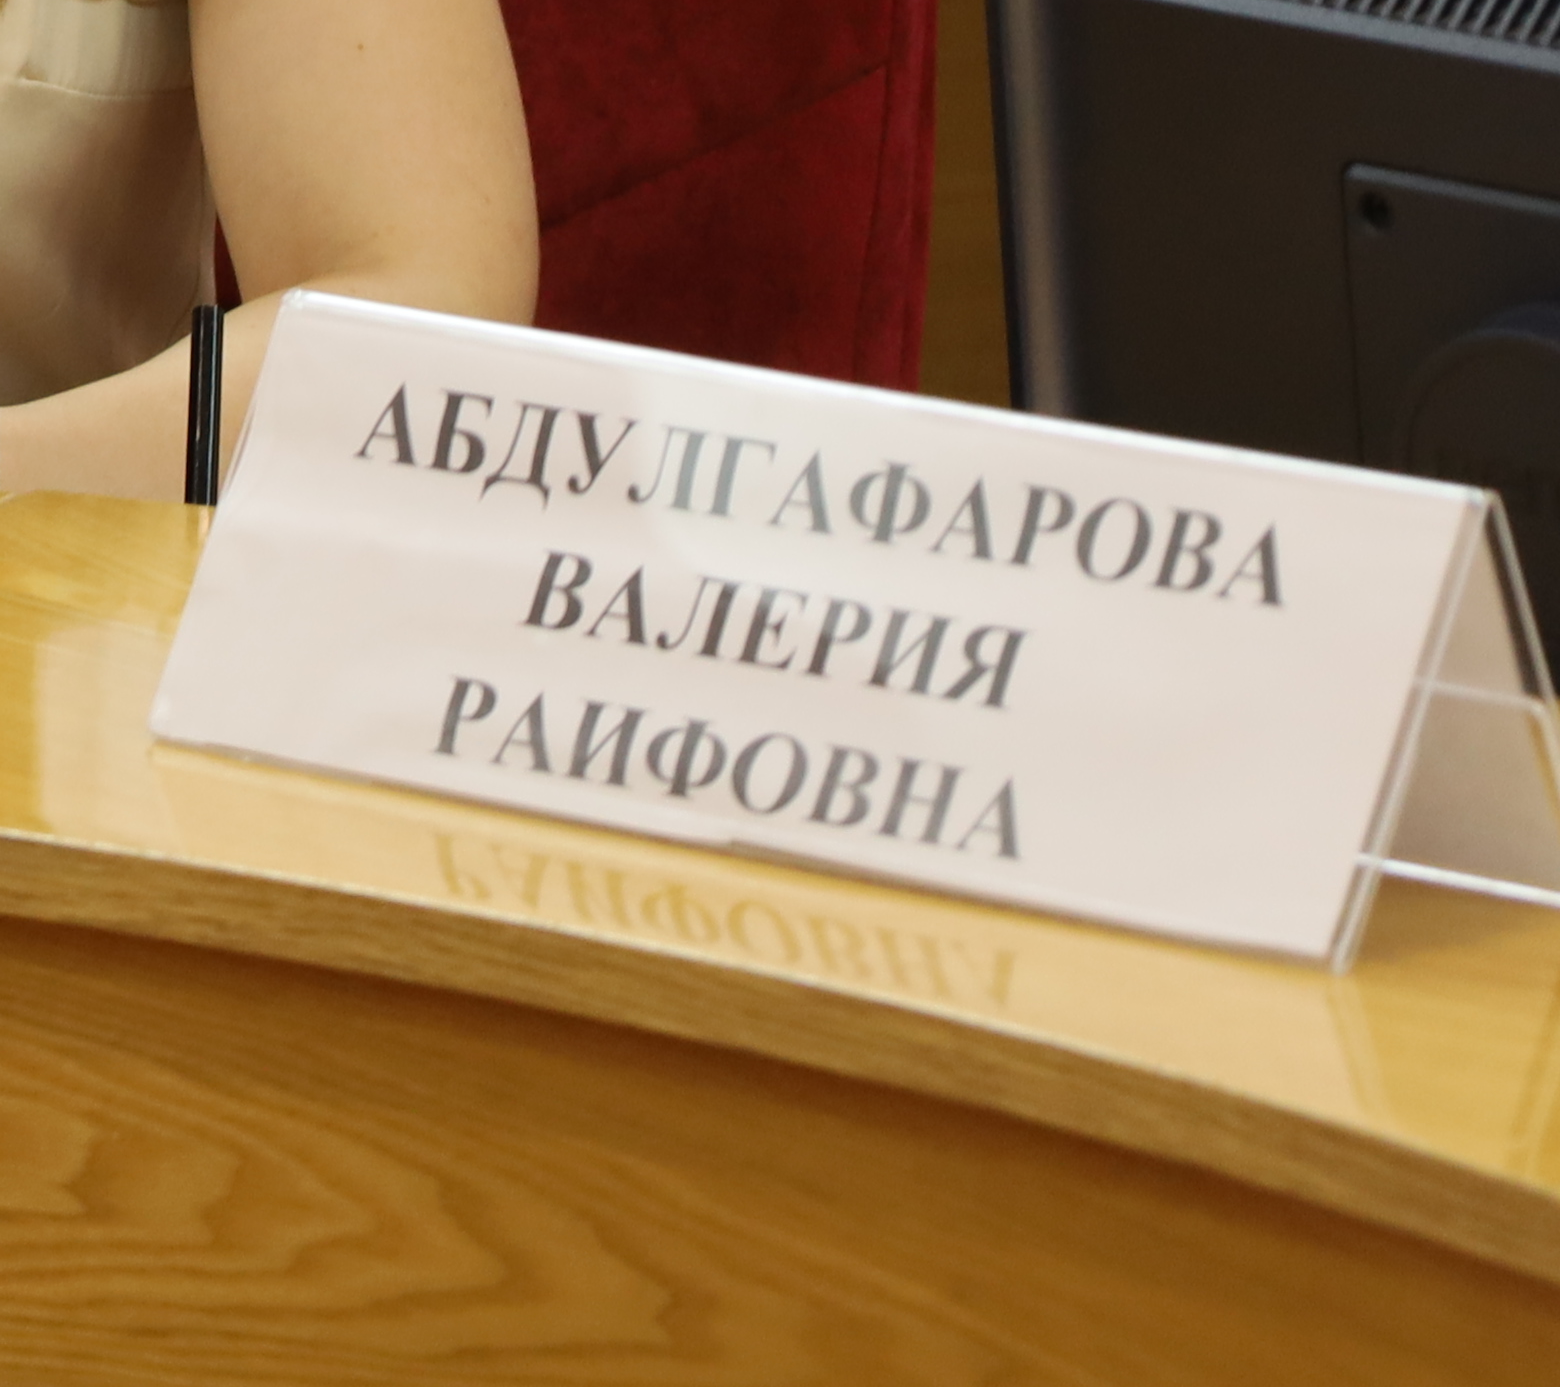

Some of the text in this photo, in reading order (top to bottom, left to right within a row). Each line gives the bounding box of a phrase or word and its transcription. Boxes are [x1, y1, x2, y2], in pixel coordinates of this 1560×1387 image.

[352, 381, 1286, 609] АБДУЛГАФАРОВА
[519, 549, 1030, 711] ВАЛЕРИЯ
[431, 675, 1024, 859] РАИФОВНА
